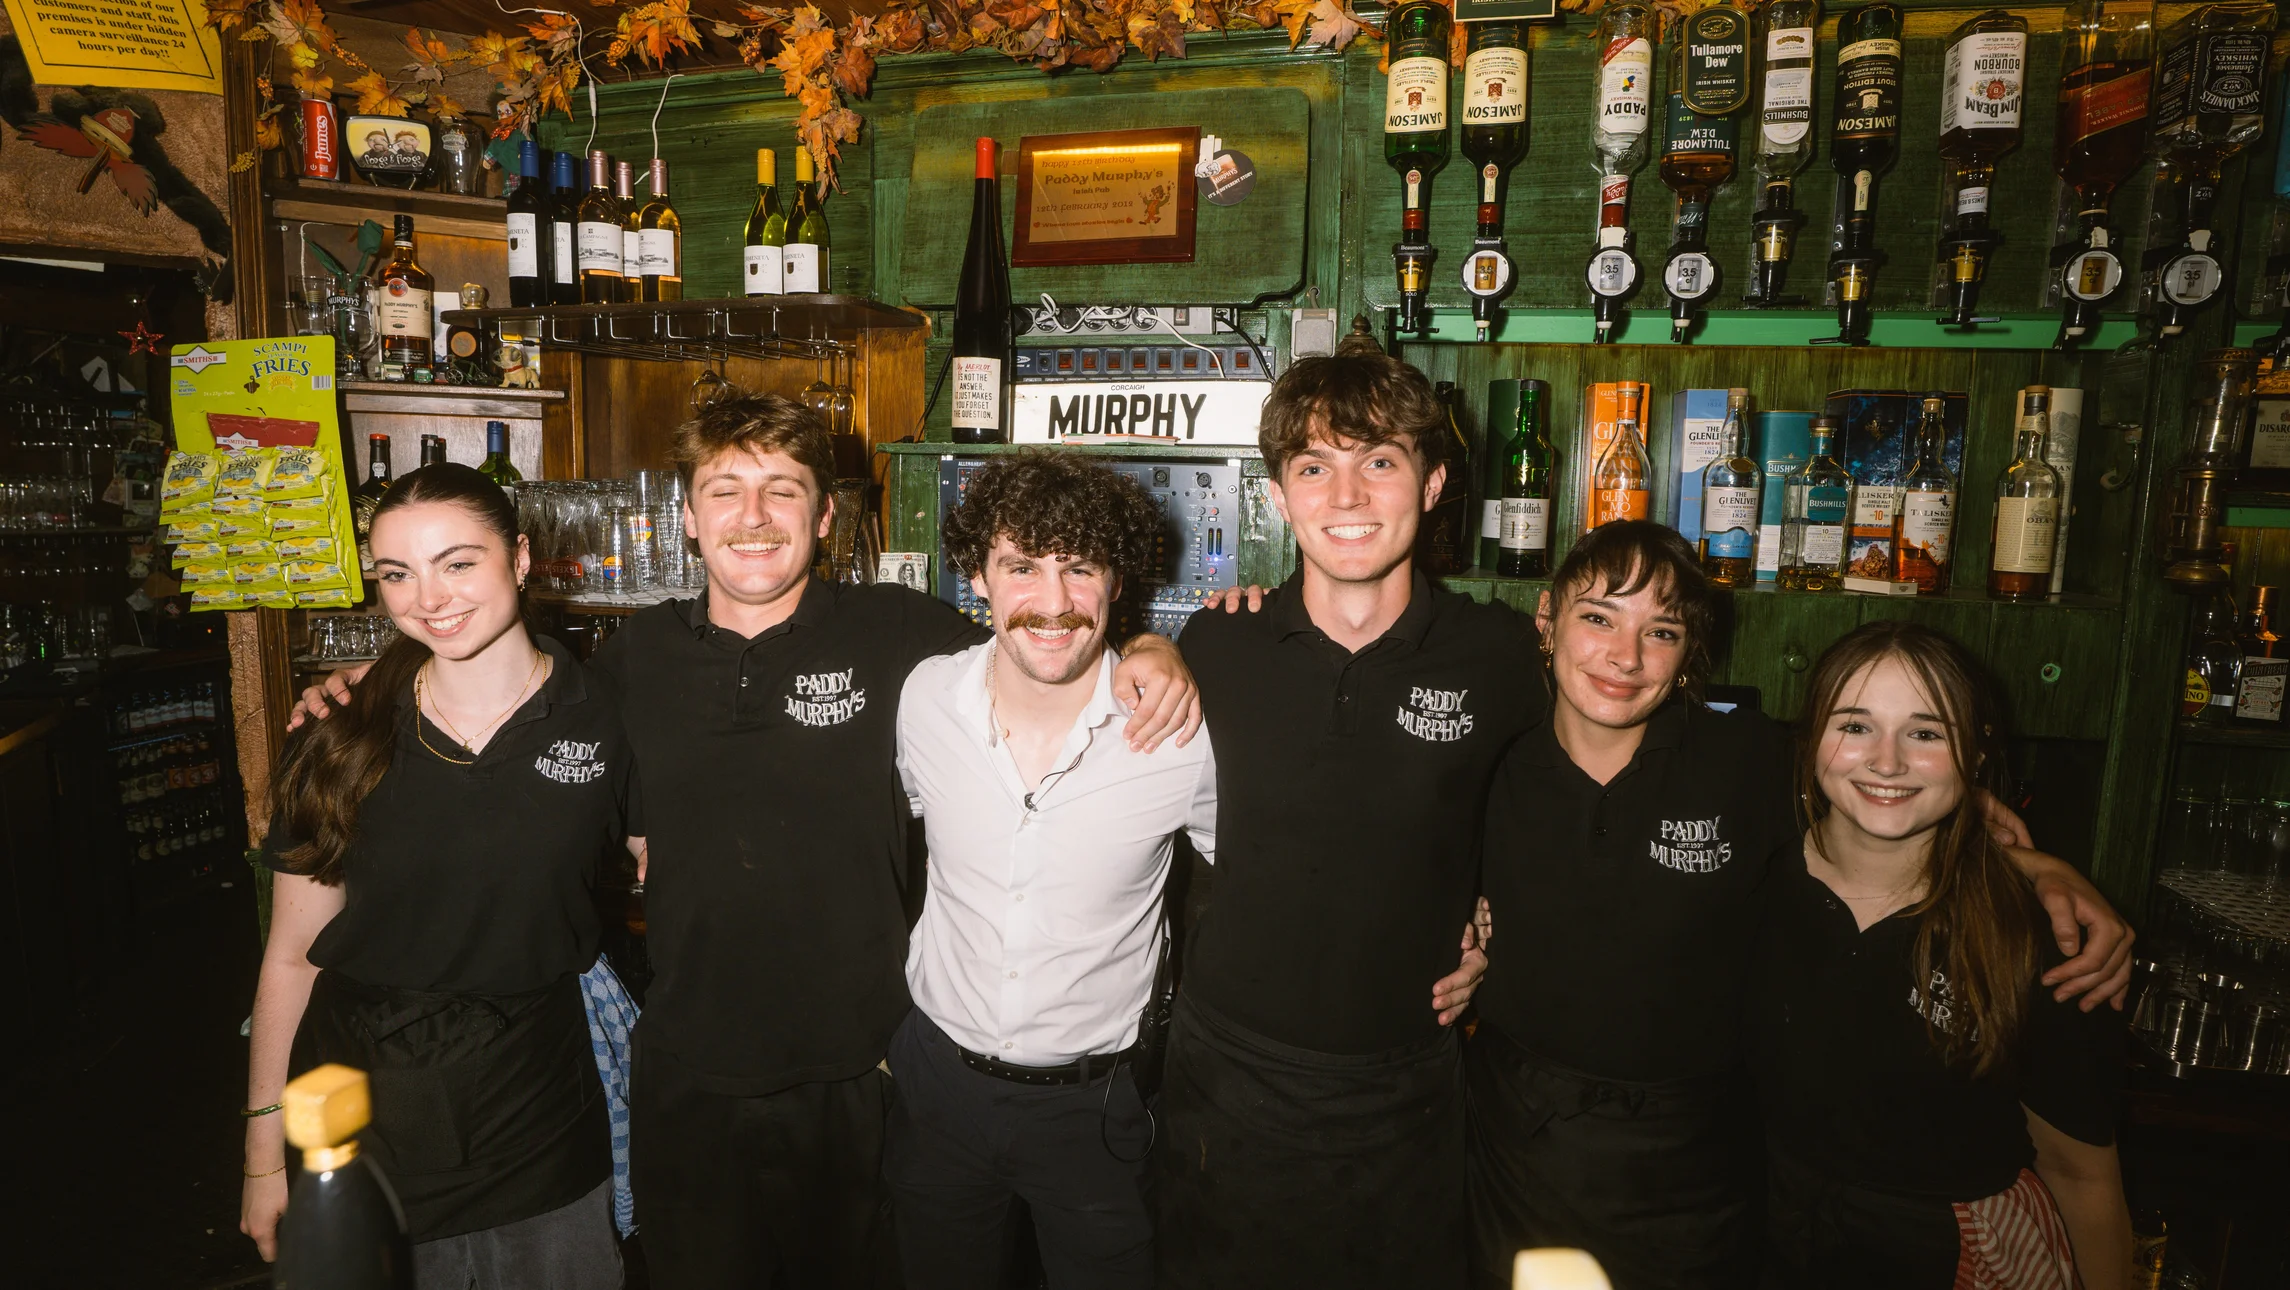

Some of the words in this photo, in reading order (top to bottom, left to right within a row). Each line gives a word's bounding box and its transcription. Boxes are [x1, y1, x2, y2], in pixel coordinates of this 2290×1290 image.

[33, 0, 97, 12] customers
[100, 6, 122, 16] and
[126, 10, 156, 22] staff,
[159, 15, 180, 25] this
[141, 0, 152, 9] of
[156, 4, 175, 13] our
[37, 11, 93, 25] premises
[96, 17, 106, 26] is
[110, 18, 143, 31] under
[147, 22, 187, 38] hidden
[50, 26, 96, 38] camera
[100, 31, 169, 47] surveillance
[172, 40, 185, 49] 24
[78, 40, 114, 52] hours
[117, 45, 136, 55] per
[140, 47, 170, 59] day!!
[1690, 44, 1743, 57] Tullamore
[1705, 56, 1729, 68] Dew
[1974, 58, 2020, 70] BOURBON
[2215, 64, 2255, 73] Tennessee
[1843, 78, 1875, 90] EDITION
[1876, 78, 1896, 86] STOUT
[1768, 99, 1795, 107] ORIGINAL
[2000, 95, 2020, 113] JIM
[2127, 93, 2148, 105] RED
[2199, 90, 2236, 110] DANIEL'S
[2236, 90, 2260, 107] JACK
[1466, 104, 1522, 119] JAMESON
[1604, 102, 1646, 116] PADDY
[1964, 96, 1998, 118] BEAM
[2086, 101, 2124, 118] LABEL
[2119, 102, 2146, 116] JOHNNIE
[1388, 112, 1443, 127] JAMESON
[1764, 110, 1808, 121] BUSHMILLS
[1837, 115, 1896, 130] JAMESON
[315, 116, 332, 162] James
[1690, 128, 1716, 138] D.E.W.
[1671, 139, 1730, 150] TULLAMORE
[1045, 173, 1089, 185] Paddy
[1092, 168, 1164, 182] Murphy's
[1112, 200, 1133, 209] 2012
[1605, 265, 1619, 273] 3.5
[1682, 268, 1696, 277] 3.5
[253, 342, 308, 356] SCAMPI
[184, 356, 213, 364] SMITHS
[251, 358, 312, 379] FRIES
[976, 374, 988, 382] THE
[972, 392, 992, 401] MAKES
[966, 401, 989, 410] FORGET
[1048, 393, 1207, 439] MURPHY
[279, 454, 313, 464] FRIES
[1602, 491, 1630, 502] GLEN
[1718, 497, 1756, 505] GLENLIVET
[1809, 499, 1846, 508] BUSHMILLS
[1609, 502, 1631, 513] MO
[1911, 508, 1952, 517] TALISKE
[1874, 510, 1884, 520] 10
[1938, 534, 1945, 544] 10
[2033, 529, 2048, 547] 14
[795, 667, 853, 695] PADDY
[1410, 686, 1468, 713] PADDY
[784, 688, 866, 727] MURPHY'S
[1396, 705, 1474, 742] MURPHY'S
[548, 739, 601, 760] PADDY
[534, 755, 606, 783] MURPHY'S
[1660, 815, 1721, 842] PADDY
[1649, 840, 1732, 873] MURPHY'S
